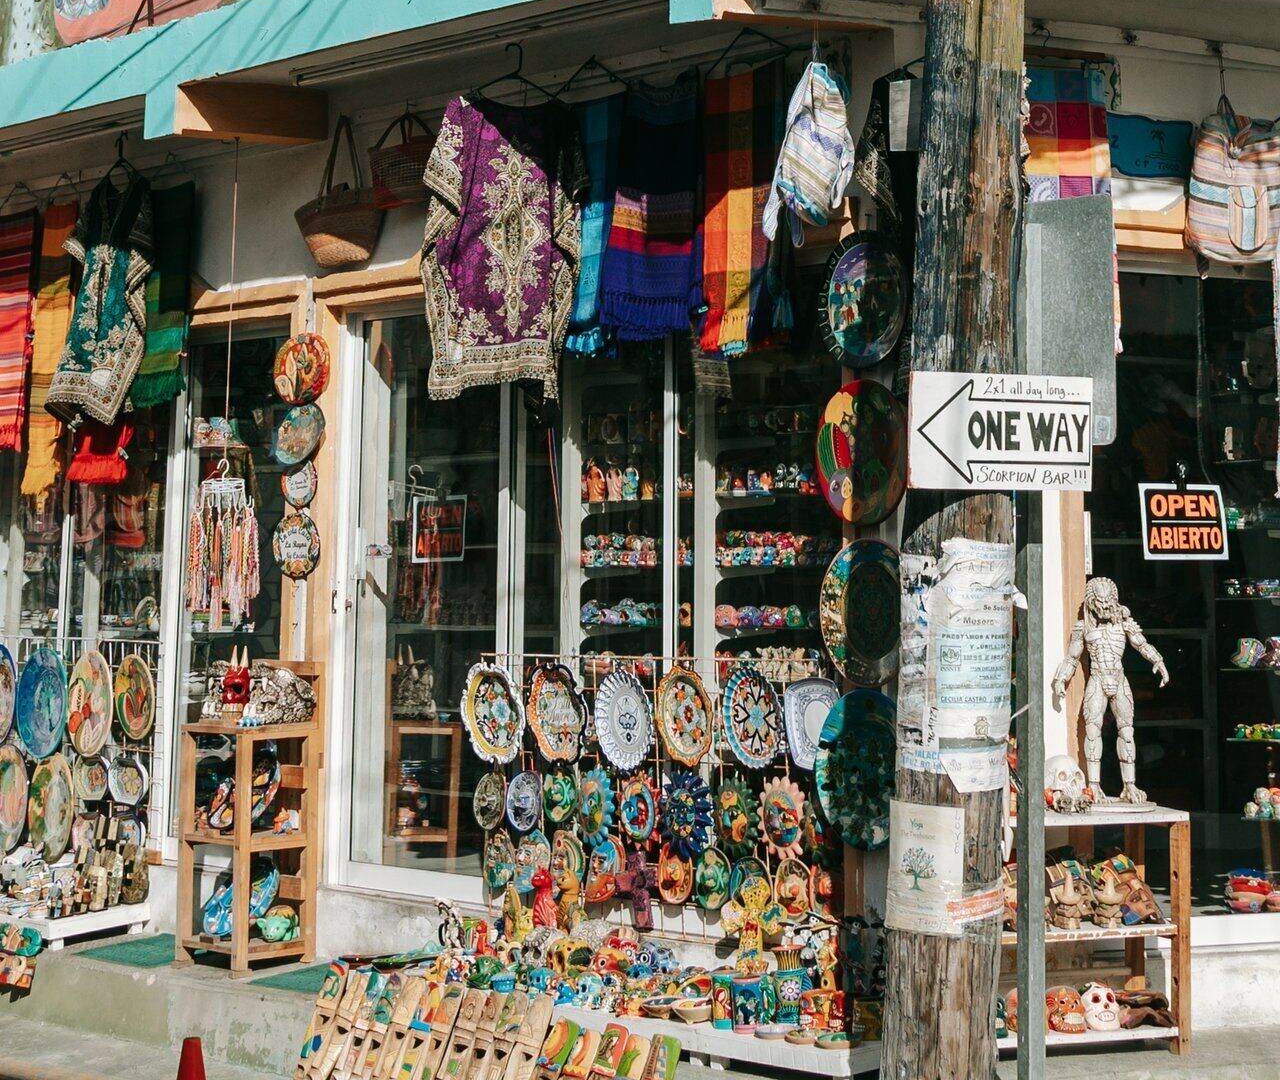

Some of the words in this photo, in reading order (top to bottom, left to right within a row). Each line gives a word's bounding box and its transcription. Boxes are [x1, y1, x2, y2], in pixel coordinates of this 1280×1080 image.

[983, 376, 1005, 395] 2x1
[1010, 380, 1023, 395] all
[1026, 381, 1043, 399] day
[968, 410, 1021, 450] ONE
[1027, 412, 1088, 452] WAY
[976, 465, 1037, 484] SCORPION
[1150, 493, 1217, 517] OPEN
[1149, 526, 1223, 550] ABIERTO
[910, 818, 924, 830] Yoga
